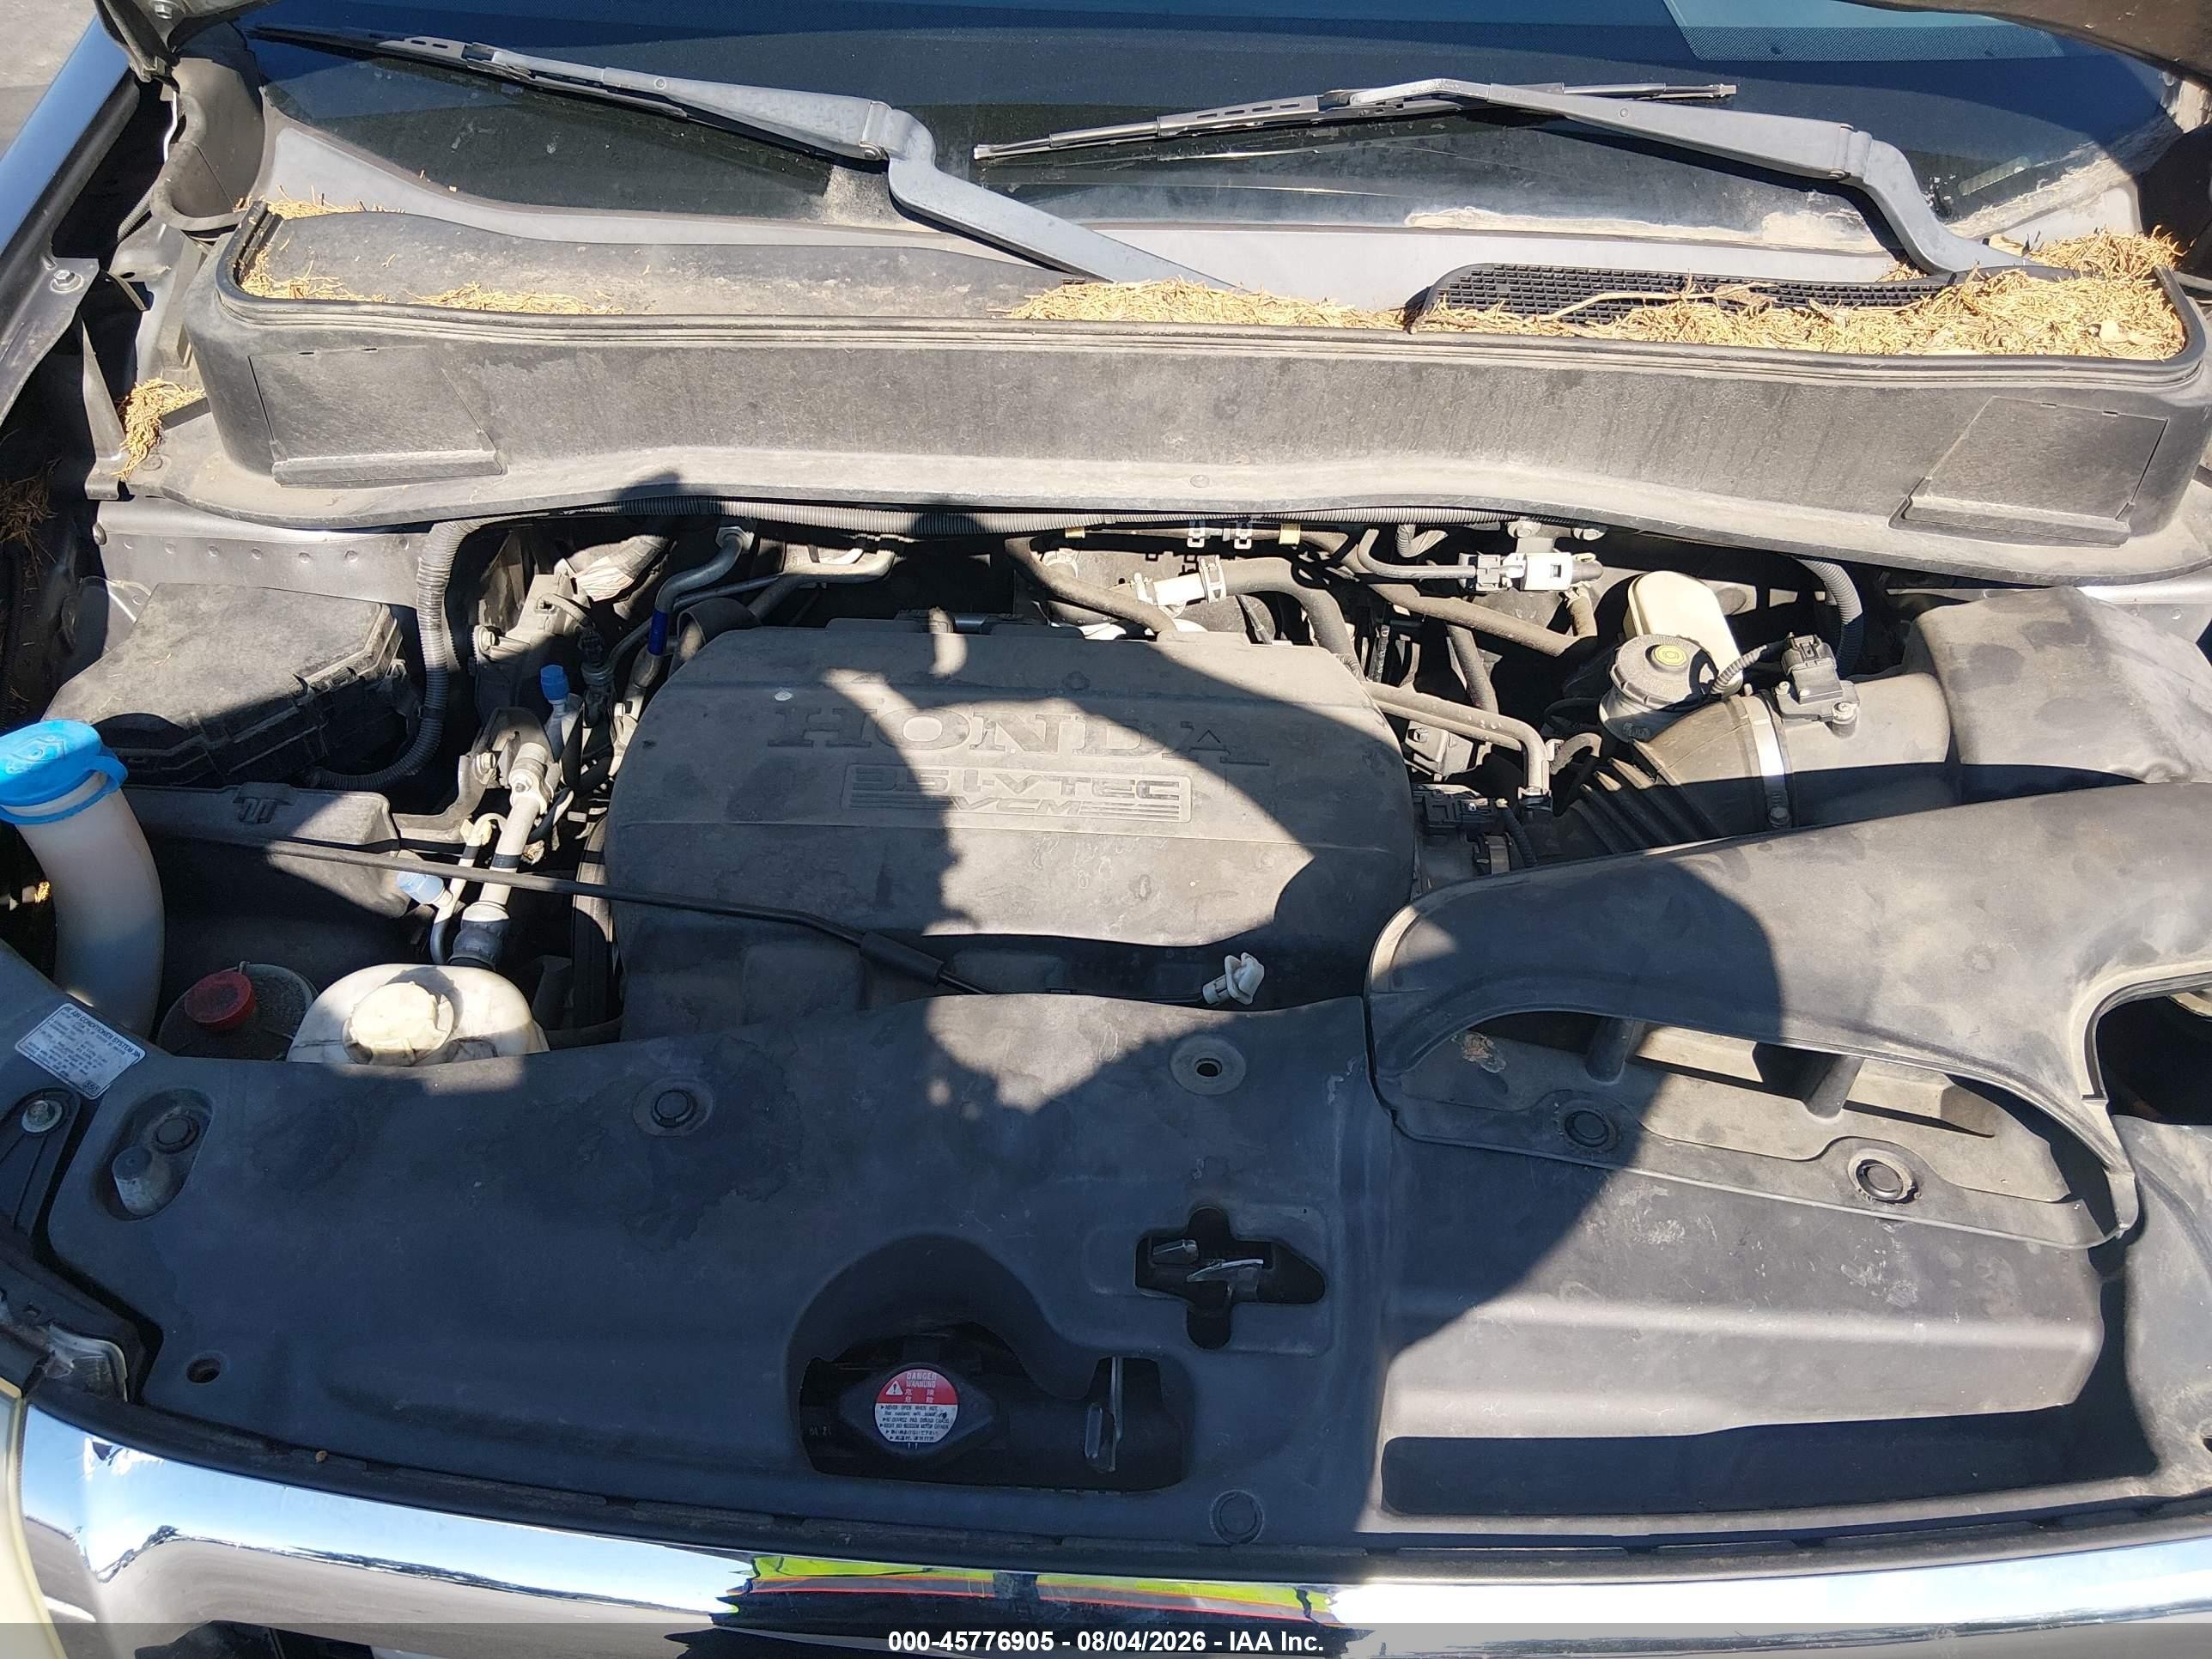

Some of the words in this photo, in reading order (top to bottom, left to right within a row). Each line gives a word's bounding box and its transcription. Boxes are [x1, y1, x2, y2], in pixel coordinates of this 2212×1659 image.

[767, 706, 1270, 767] HONDA
[852, 768, 949, 793] 3.5
[951, 796, 1081, 816] VCM
[70, 1010, 82, 1018] AIR
[79, 1016, 114, 1039] CONDITIONER
[111, 1036, 135, 1053] SYSTEM
